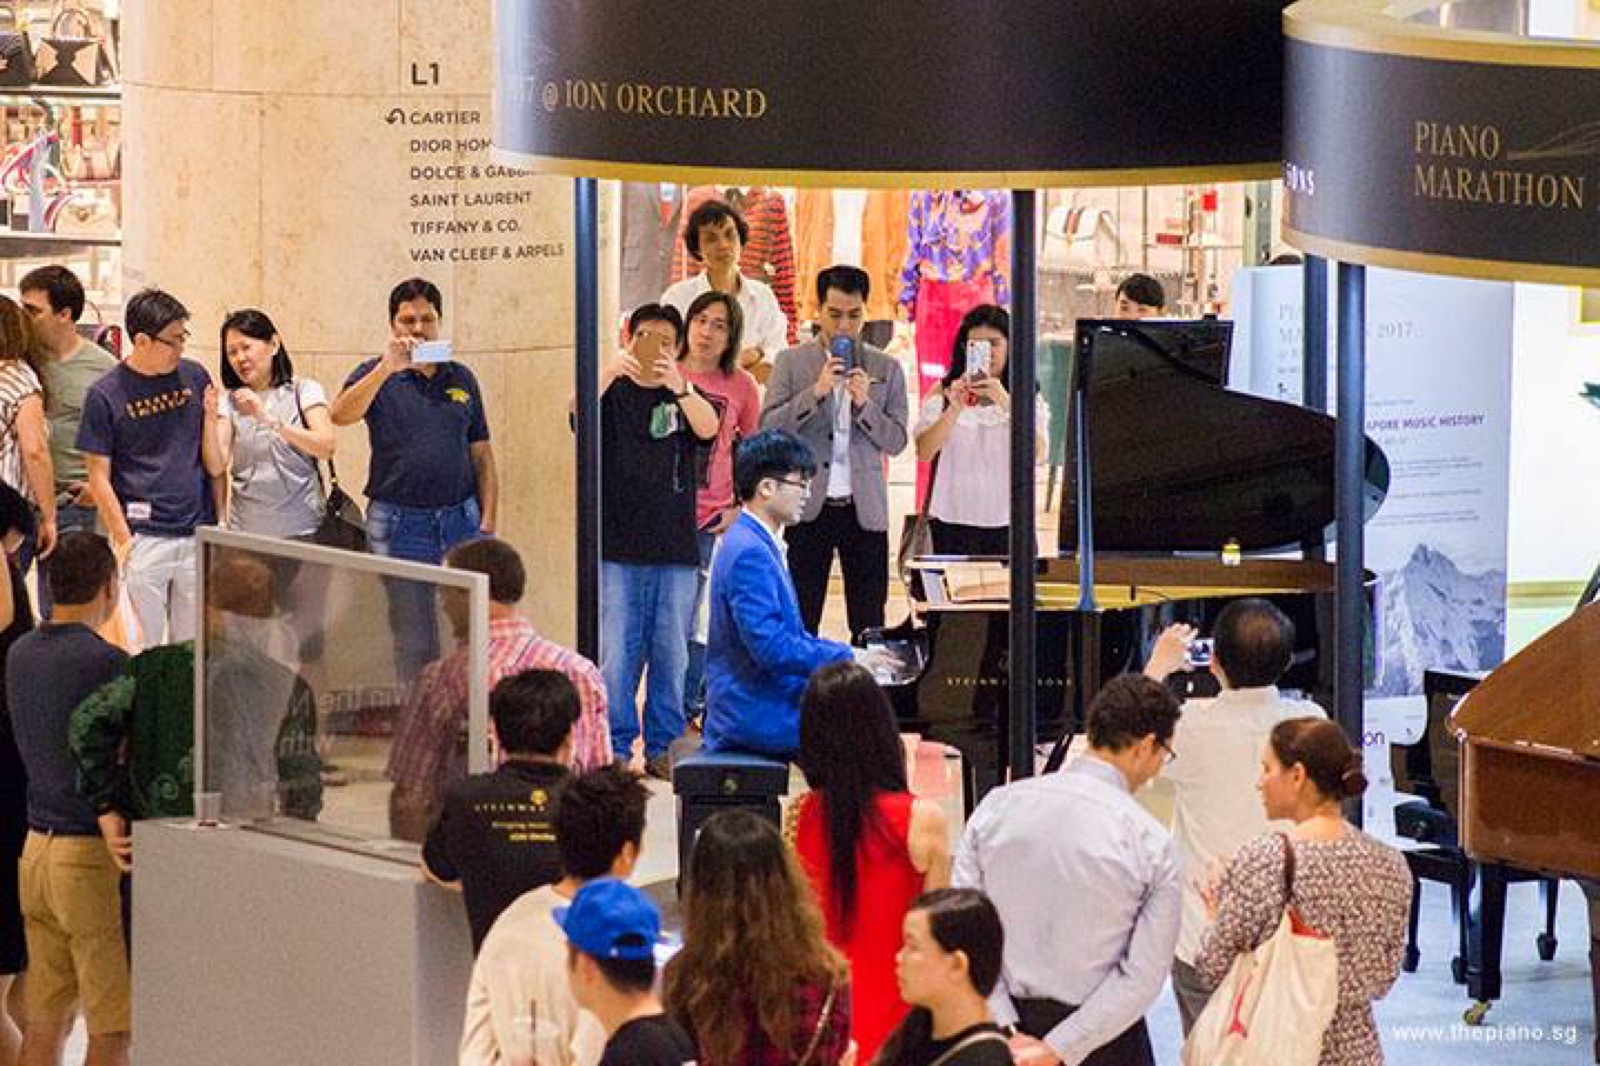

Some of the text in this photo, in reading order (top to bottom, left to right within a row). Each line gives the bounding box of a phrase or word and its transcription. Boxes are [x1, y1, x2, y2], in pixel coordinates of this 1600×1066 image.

[412, 63, 439, 85] L1
[566, 79, 607, 111] ION
[617, 83, 767, 119] ORCHARD
[410, 111, 481, 125] CARTIER
[410, 139, 495, 152] DIOR HOM
[1414, 121, 1500, 161] PIANO
[410, 166, 466, 180] DOLCE
[471, 165, 481, 178] &
[1414, 166, 1585, 209] MARATHON
[410, 191, 532, 207] SAINT LAURENT
[411, 221, 479, 234] TIFFANY
[482, 221, 493, 233] &
[410, 243, 565, 261] VAN CLEEF & ARPELS
[1403, 416, 1437, 428] MUSIC
[1440, 413, 1485, 427] HISTORY
[1362, 730, 1386, 747] on
